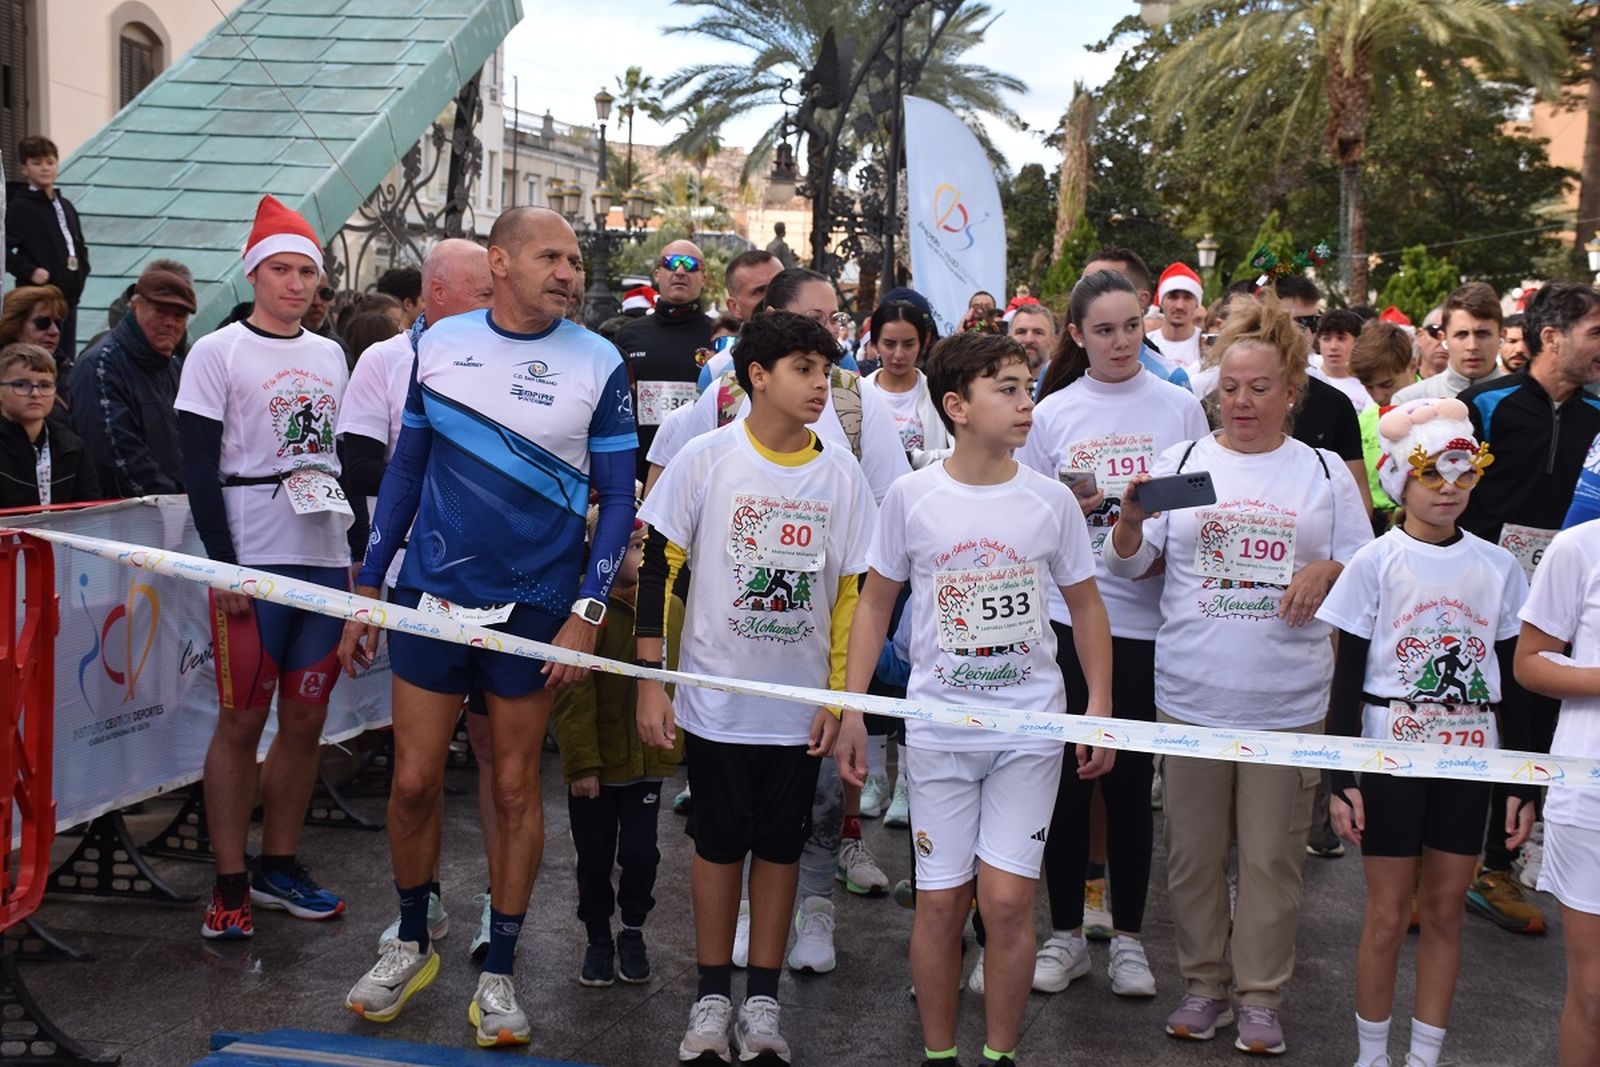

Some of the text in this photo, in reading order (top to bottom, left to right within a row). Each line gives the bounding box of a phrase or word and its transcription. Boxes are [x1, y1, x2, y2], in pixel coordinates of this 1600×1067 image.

[1107, 455, 1150, 477] 191
[780, 524, 812, 548] 80
[1239, 537, 1286, 561] 190
[981, 592, 1031, 621] 533
[1208, 594, 1277, 613] Mercedes
[397, 617, 428, 632] Ceuta
[741, 615, 807, 636] Mohamed
[132, 704, 164, 721] DEPORTES
[1018, 722, 1065, 736] Deporte
[1438, 729, 1485, 748] 279
[1153, 735, 1200, 749] Deporte
[1291, 745, 1341, 761] Deporte
[1437, 756, 1489, 770] Deporte
